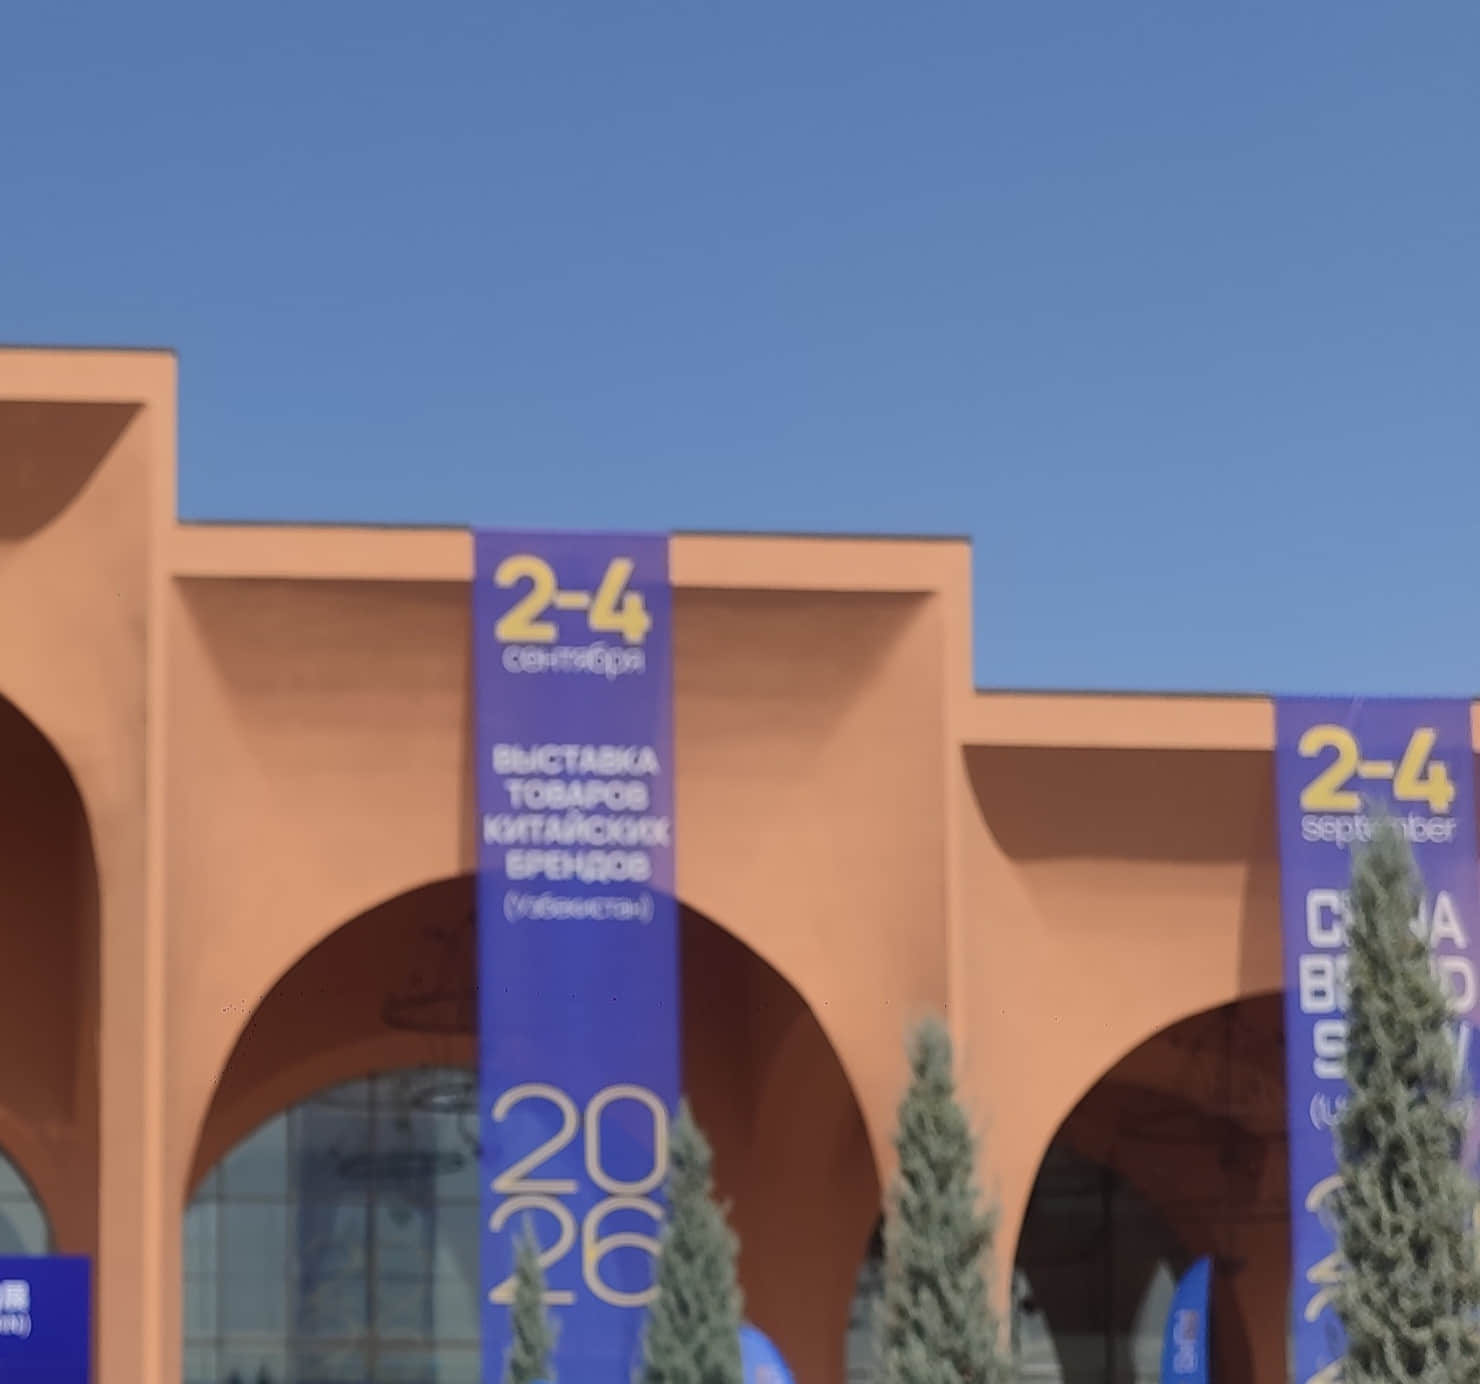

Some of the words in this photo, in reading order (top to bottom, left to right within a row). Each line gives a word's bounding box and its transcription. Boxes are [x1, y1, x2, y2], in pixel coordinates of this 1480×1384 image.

[494, 554, 652, 644] 2-4
[502, 641, 645, 681] сентября
[492, 743, 660, 775] ВЫСТАВКА
[1298, 724, 1456, 813] 2-4
[504, 778, 649, 811] ТОВАРОВ
[483, 808, 670, 847] КИТАЙСКИХ
[505, 848, 651, 884] БРЕНДОВ
[491, 1083, 669, 1196] 20
[488, 1194, 664, 1308] 26
